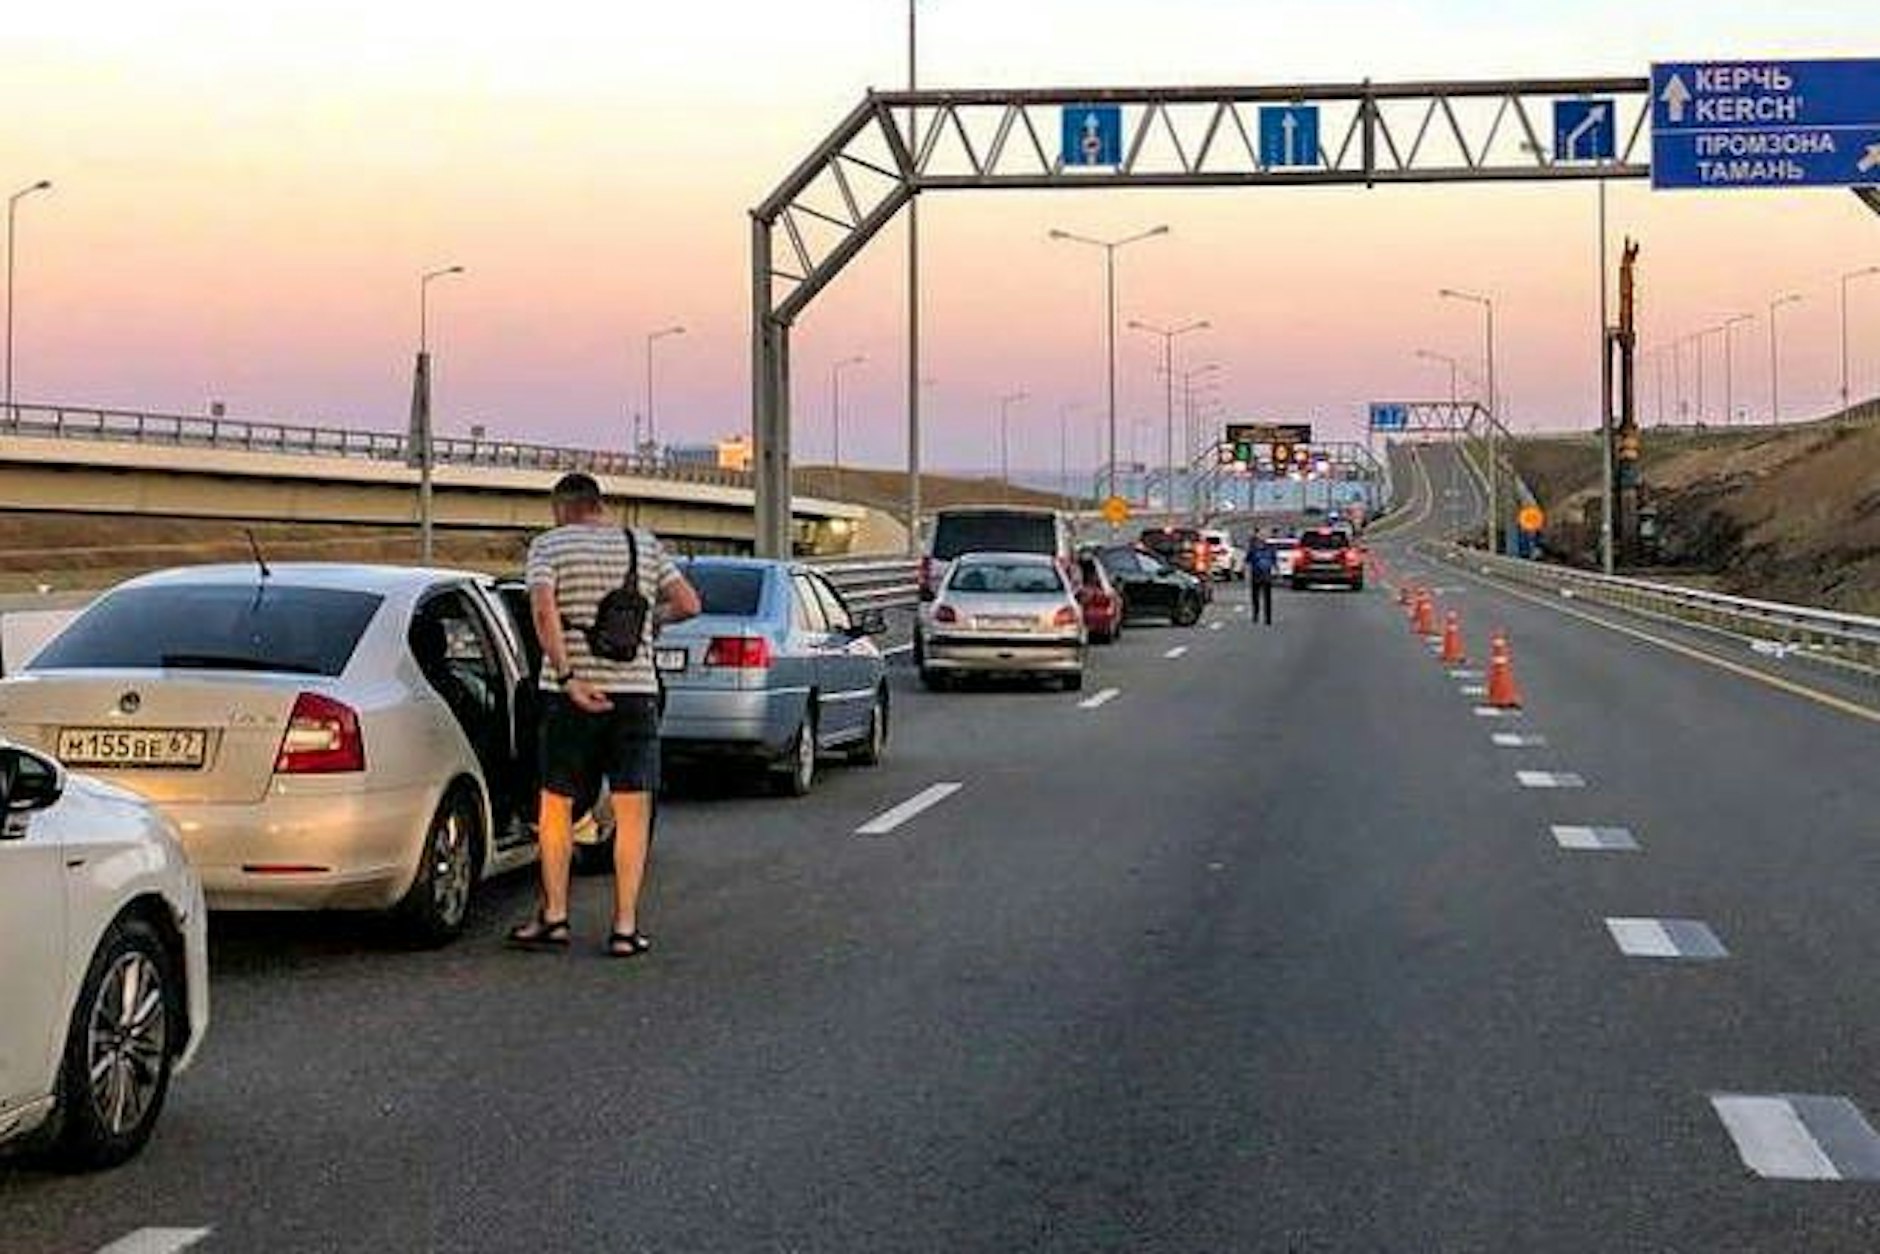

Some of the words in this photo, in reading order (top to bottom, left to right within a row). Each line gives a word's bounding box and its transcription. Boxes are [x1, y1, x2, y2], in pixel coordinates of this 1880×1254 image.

[1695, 67, 1792, 91] КЕРЧЬ
[1695, 132, 1836, 155] ПРОМЗОНА
[1696, 159, 1804, 182] ТАМАНЬ
